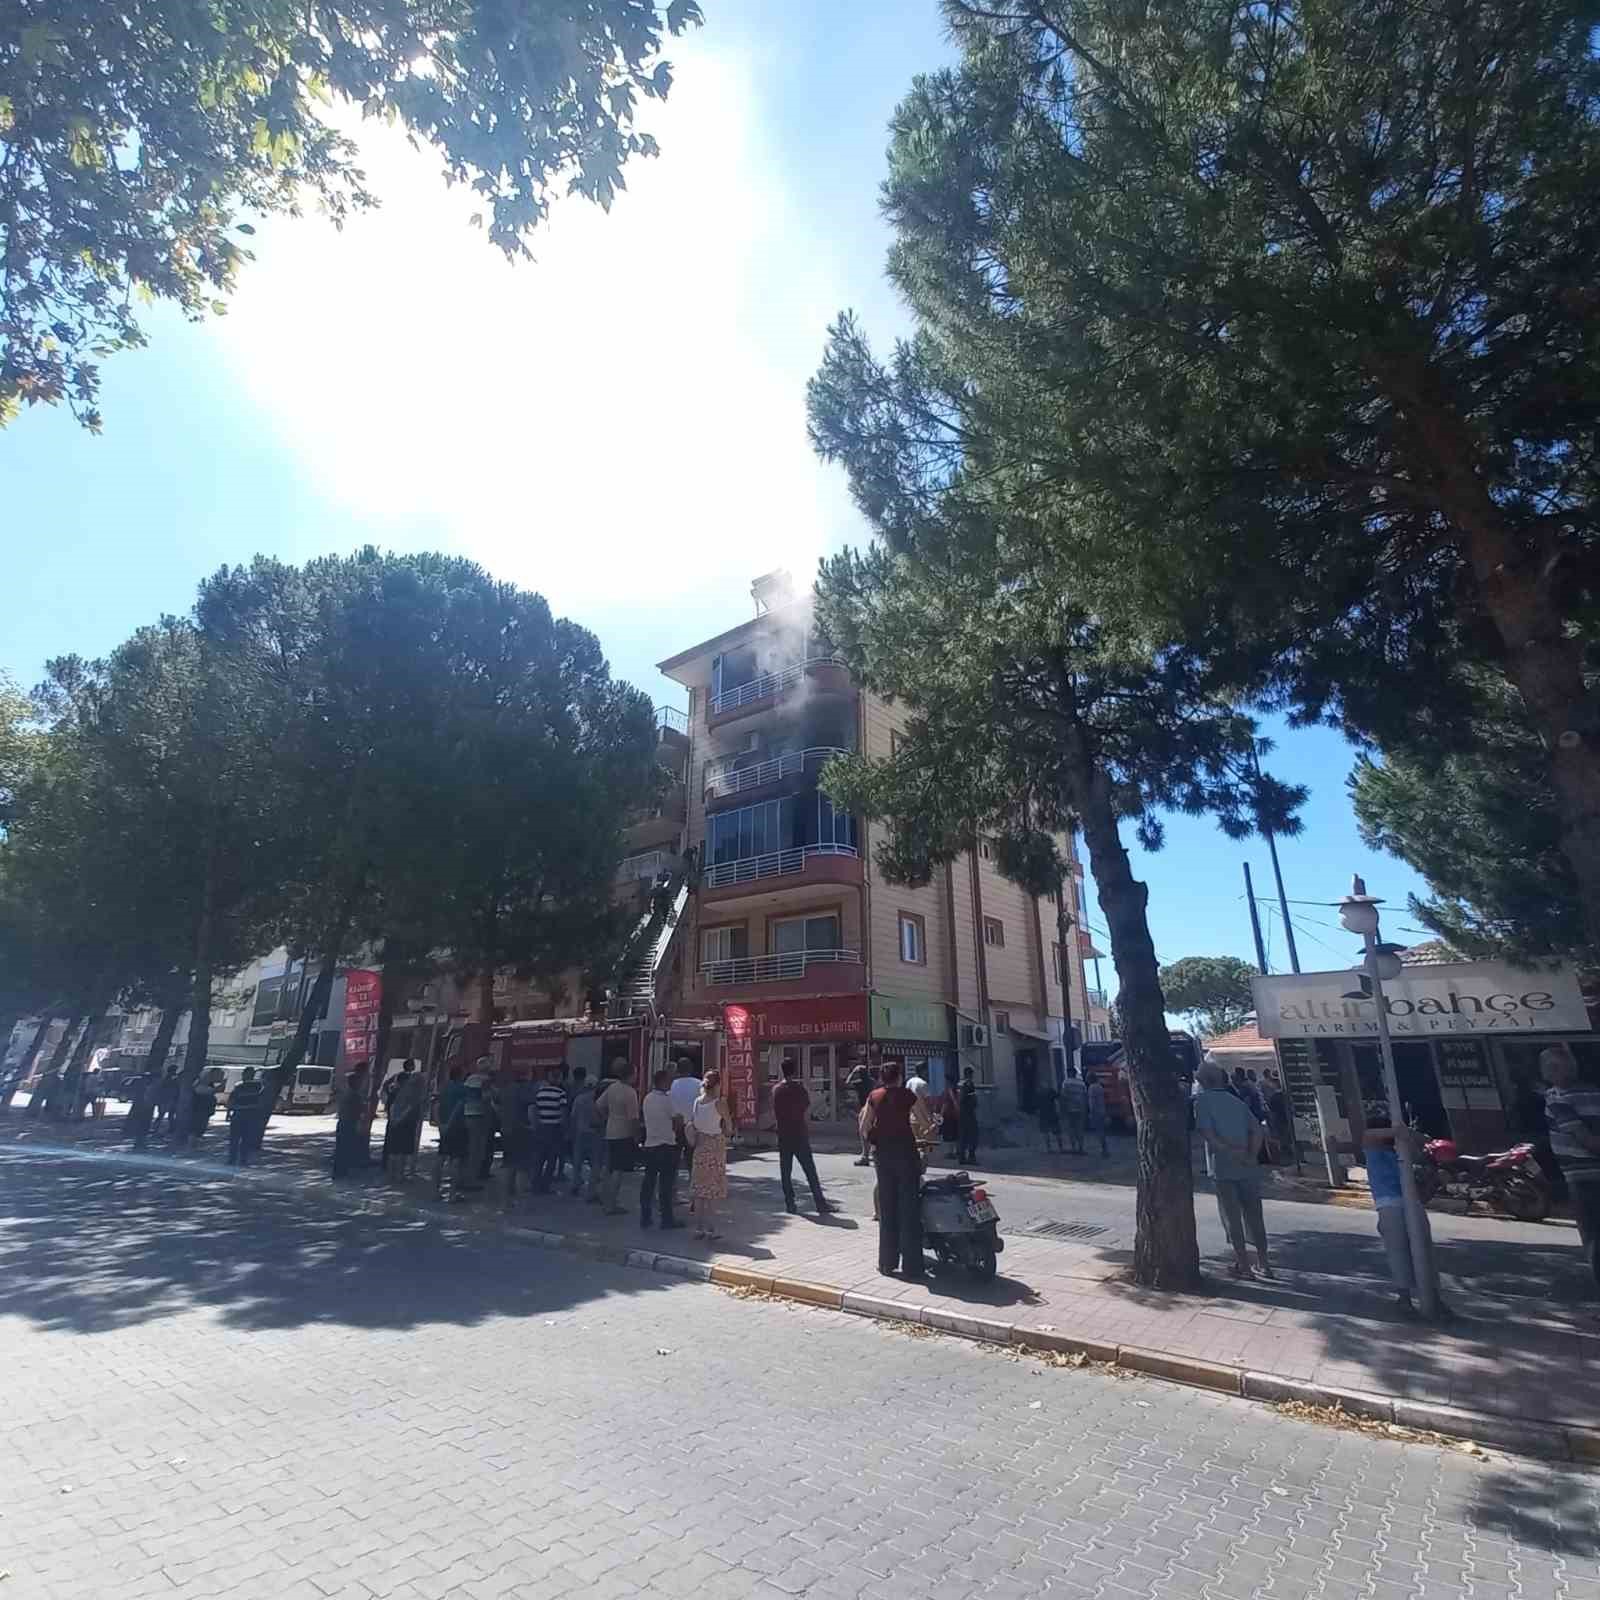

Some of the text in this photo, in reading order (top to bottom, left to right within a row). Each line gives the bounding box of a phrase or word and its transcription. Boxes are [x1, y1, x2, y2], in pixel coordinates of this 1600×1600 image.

[1301, 1016, 1536, 1034] TARIM & PEYZAJ
